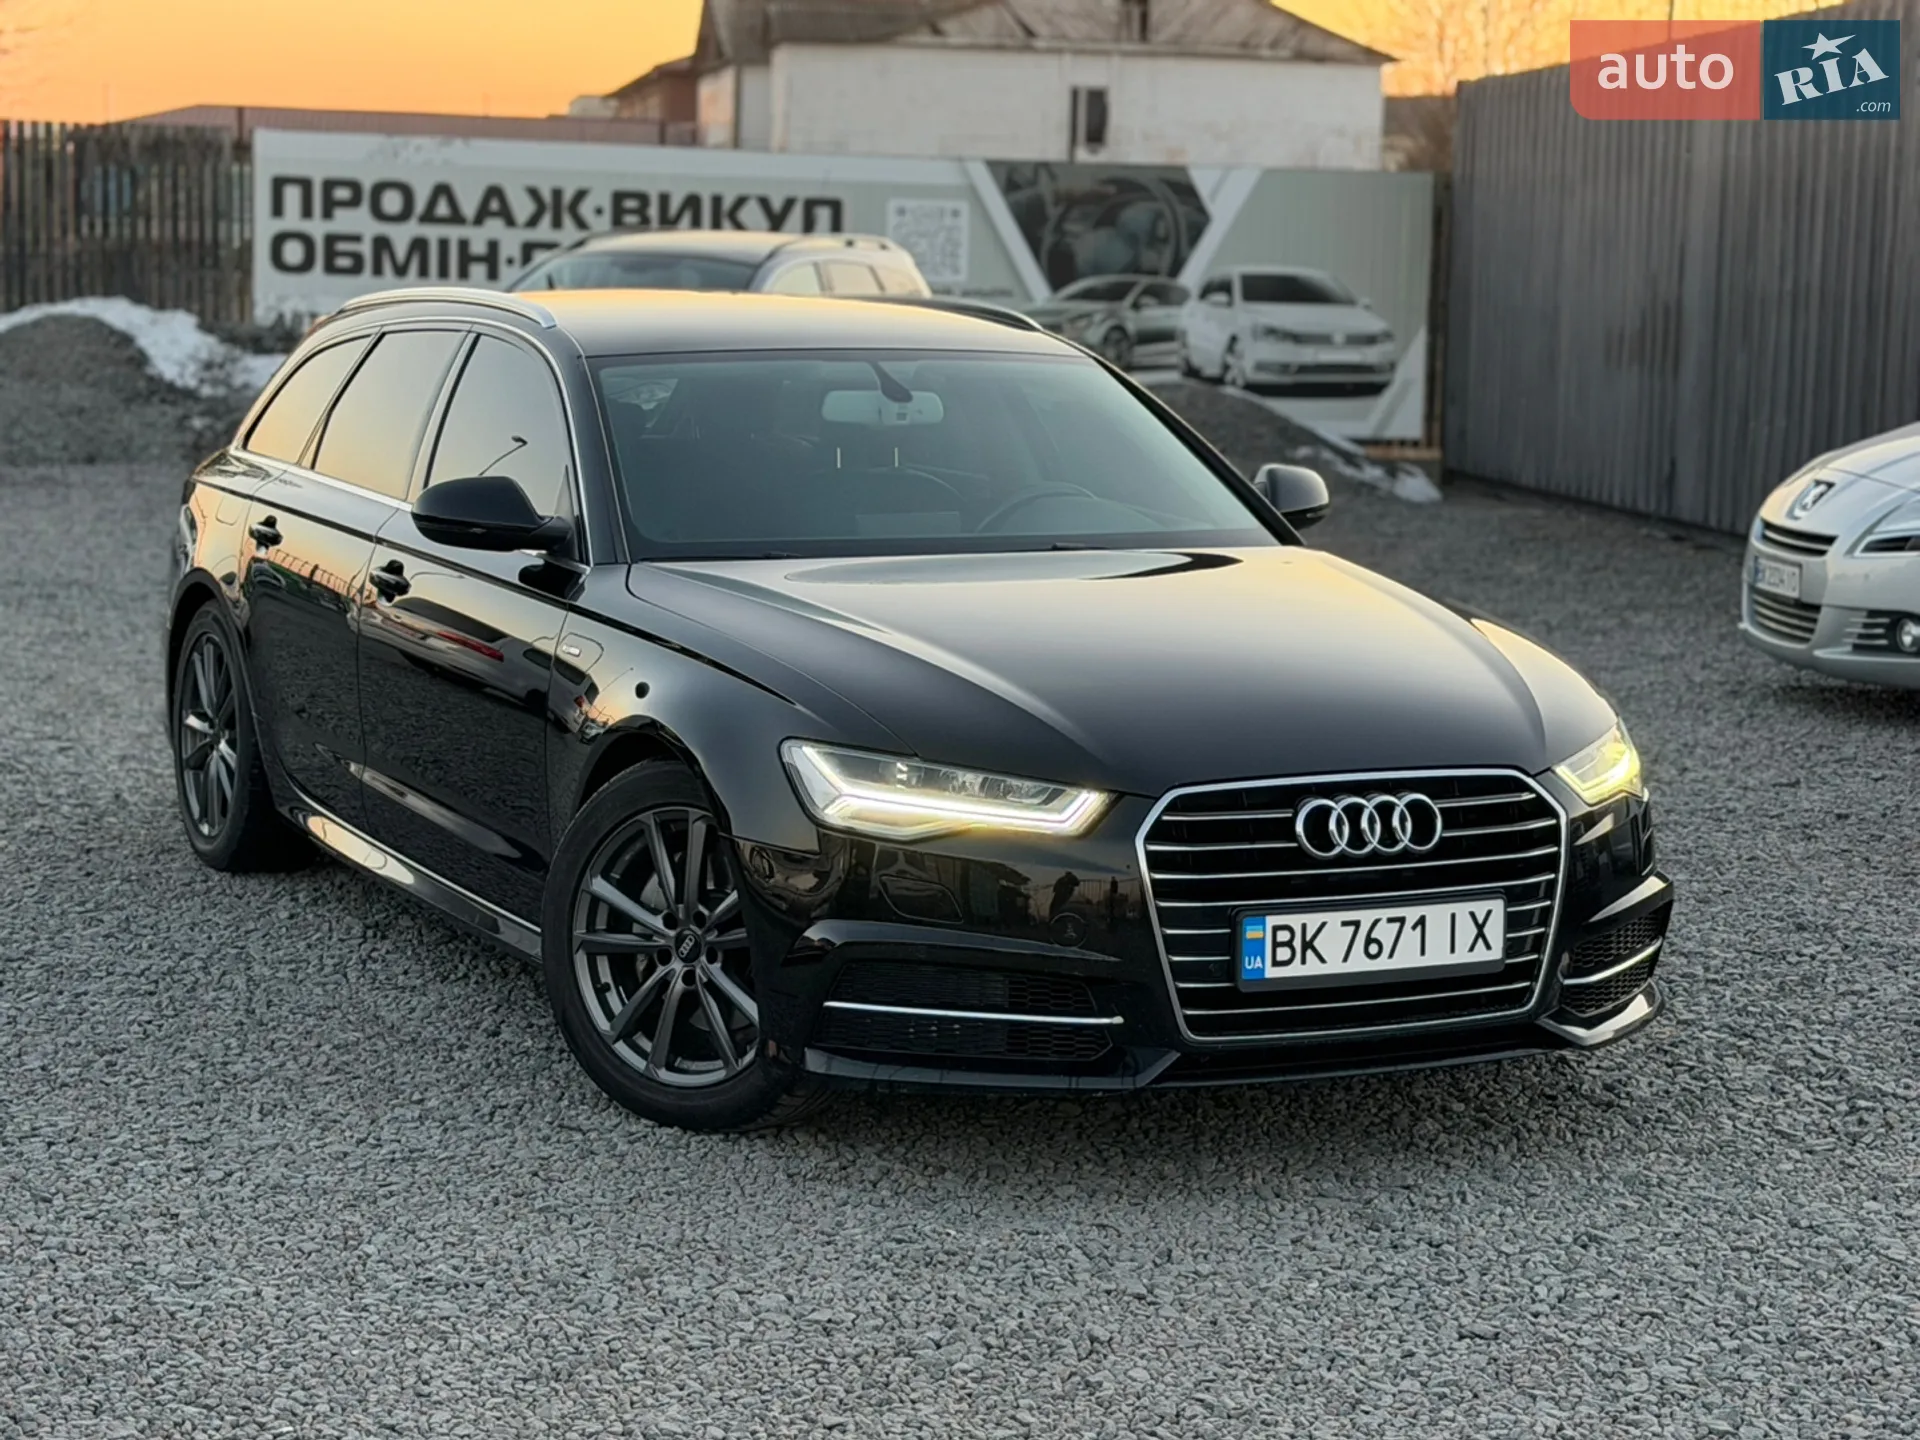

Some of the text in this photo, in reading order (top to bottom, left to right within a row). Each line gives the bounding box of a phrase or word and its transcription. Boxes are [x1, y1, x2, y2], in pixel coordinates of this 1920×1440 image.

[1271, 909, 1493, 968] BK 7671 IX
[1245, 956, 1263, 969] UA
